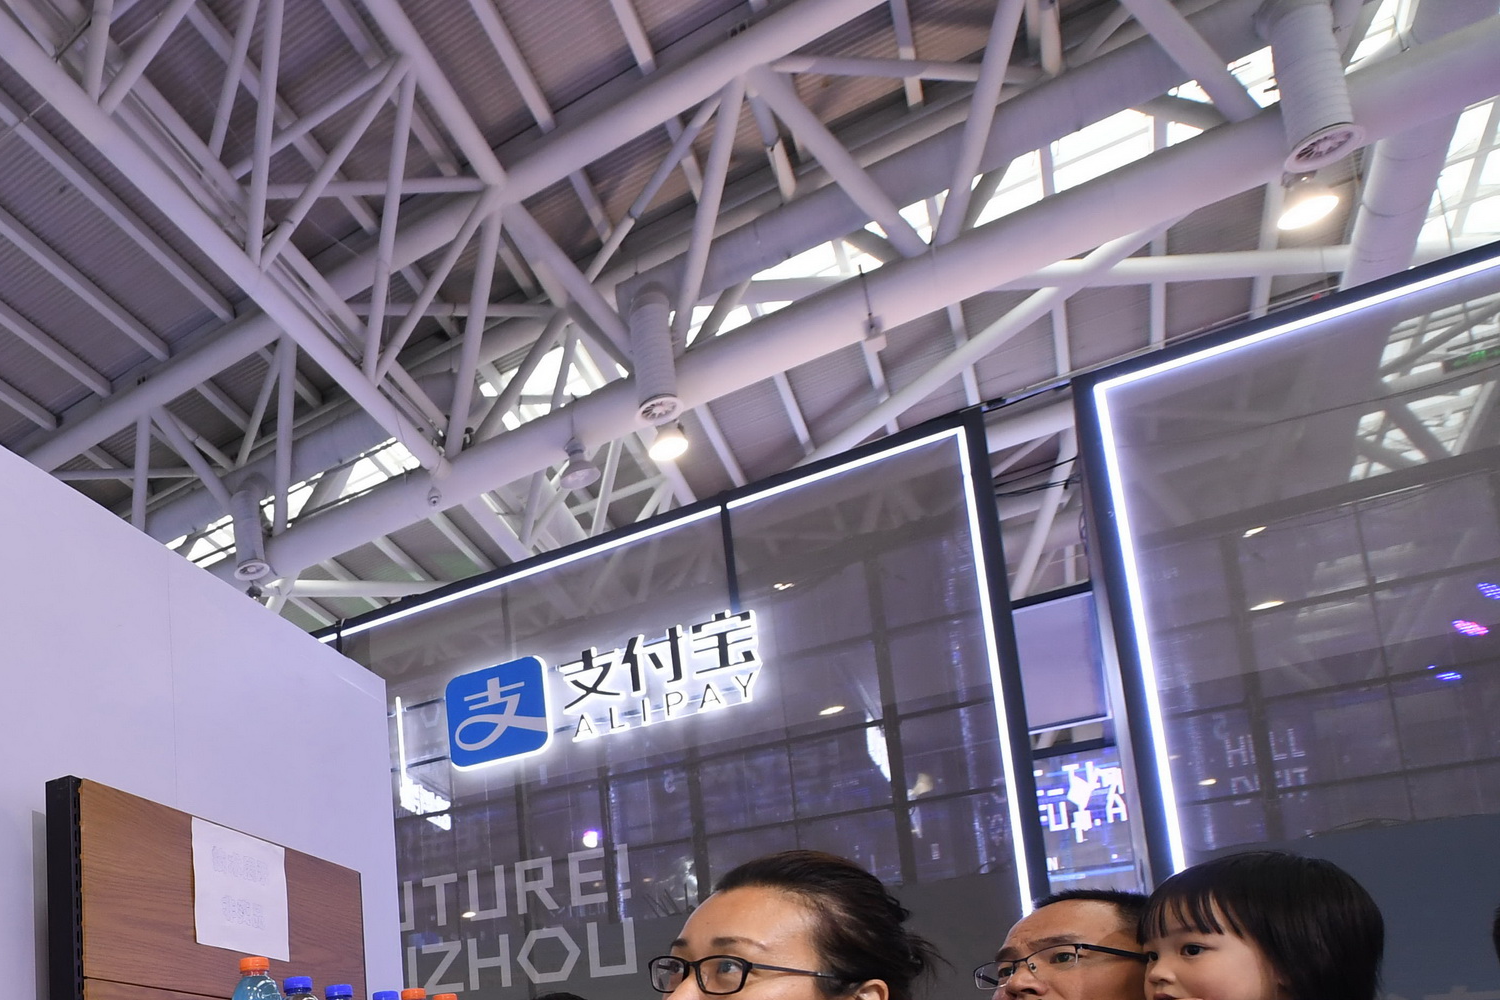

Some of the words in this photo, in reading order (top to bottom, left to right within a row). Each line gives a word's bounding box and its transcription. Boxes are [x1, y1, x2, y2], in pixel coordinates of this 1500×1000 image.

[562, 609, 761, 711] 支付宝
[572, 670, 758, 742] ALIPAY
